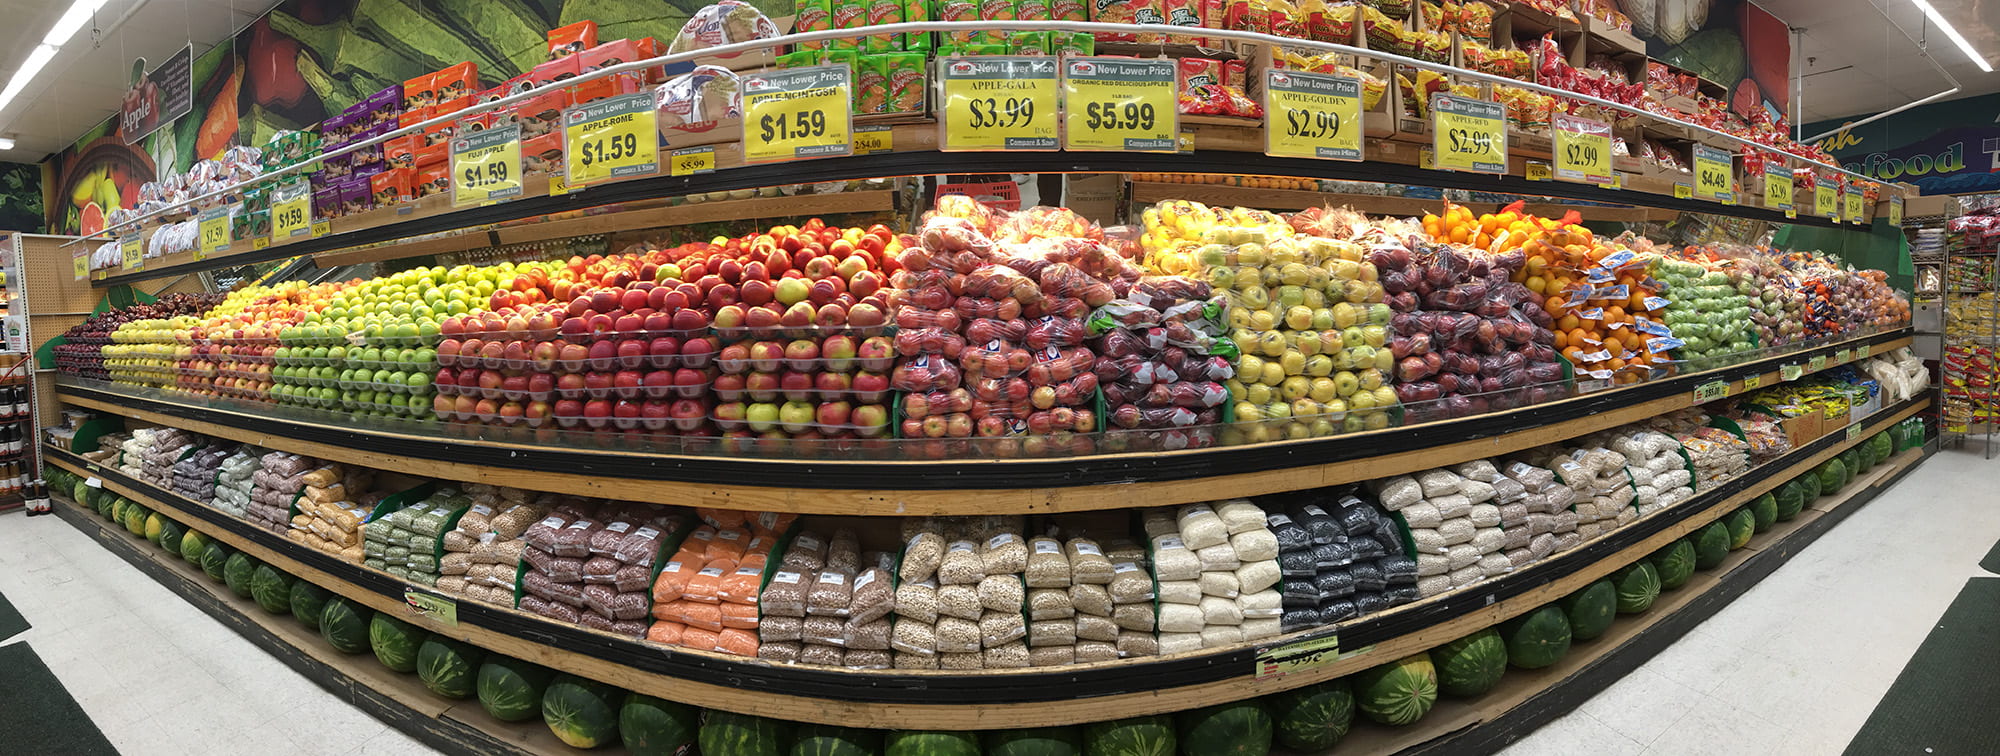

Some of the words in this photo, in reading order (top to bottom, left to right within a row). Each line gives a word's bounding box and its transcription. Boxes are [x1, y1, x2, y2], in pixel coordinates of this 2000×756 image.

[979, 63, 999, 74] New
[1001, 63, 1029, 73] Lower
[1097, 65, 1118, 74] New
[1120, 65, 1147, 76] Lower
[1149, 66, 1172, 76] Price
[771, 78, 789, 87] New
[791, 76, 816, 84] Lower
[820, 72, 843, 81] Price
[970, 81, 1037, 90] APPLE-GALA
[1293, 78, 1310, 87] New
[1312, 80, 1334, 90] Lower
[1336, 82, 1356, 93] Price
[1281, 93, 1347, 105] APPLE-GOLDEN
[122, 98, 151, 133] Apple
[588, 108, 604, 118] New
[605, 102, 627, 113] Lower
[632, 99, 651, 109] Price
[969, 97, 1034, 130] $3.99
[1086, 101, 1155, 132] $5.99
[582, 114, 634, 132] APPLE-ROME
[760, 109, 826, 144] $1.59
[1287, 108, 1340, 139] $2.99
[1451, 116, 1489, 126] APPLE-RED
[470, 138, 482, 146] New
[484, 134, 501, 144] Lower
[502, 130, 519, 140] Price
[854, 139, 881, 150] 2/$4.00
[1128, 139, 1153, 147] Compare
[1449, 128, 1490, 155] $2.99
[468, 150, 482, 159] FUJI
[581, 133, 637, 168] $1.59
[1566, 144, 1598, 167] $2.99
[681, 160, 705, 170] $5.99
[465, 161, 508, 191] $1.59
[1702, 170, 1725, 188] $4.49
[1771, 184, 1787, 199] $2.99
[206, 226, 224, 244] $1.59
